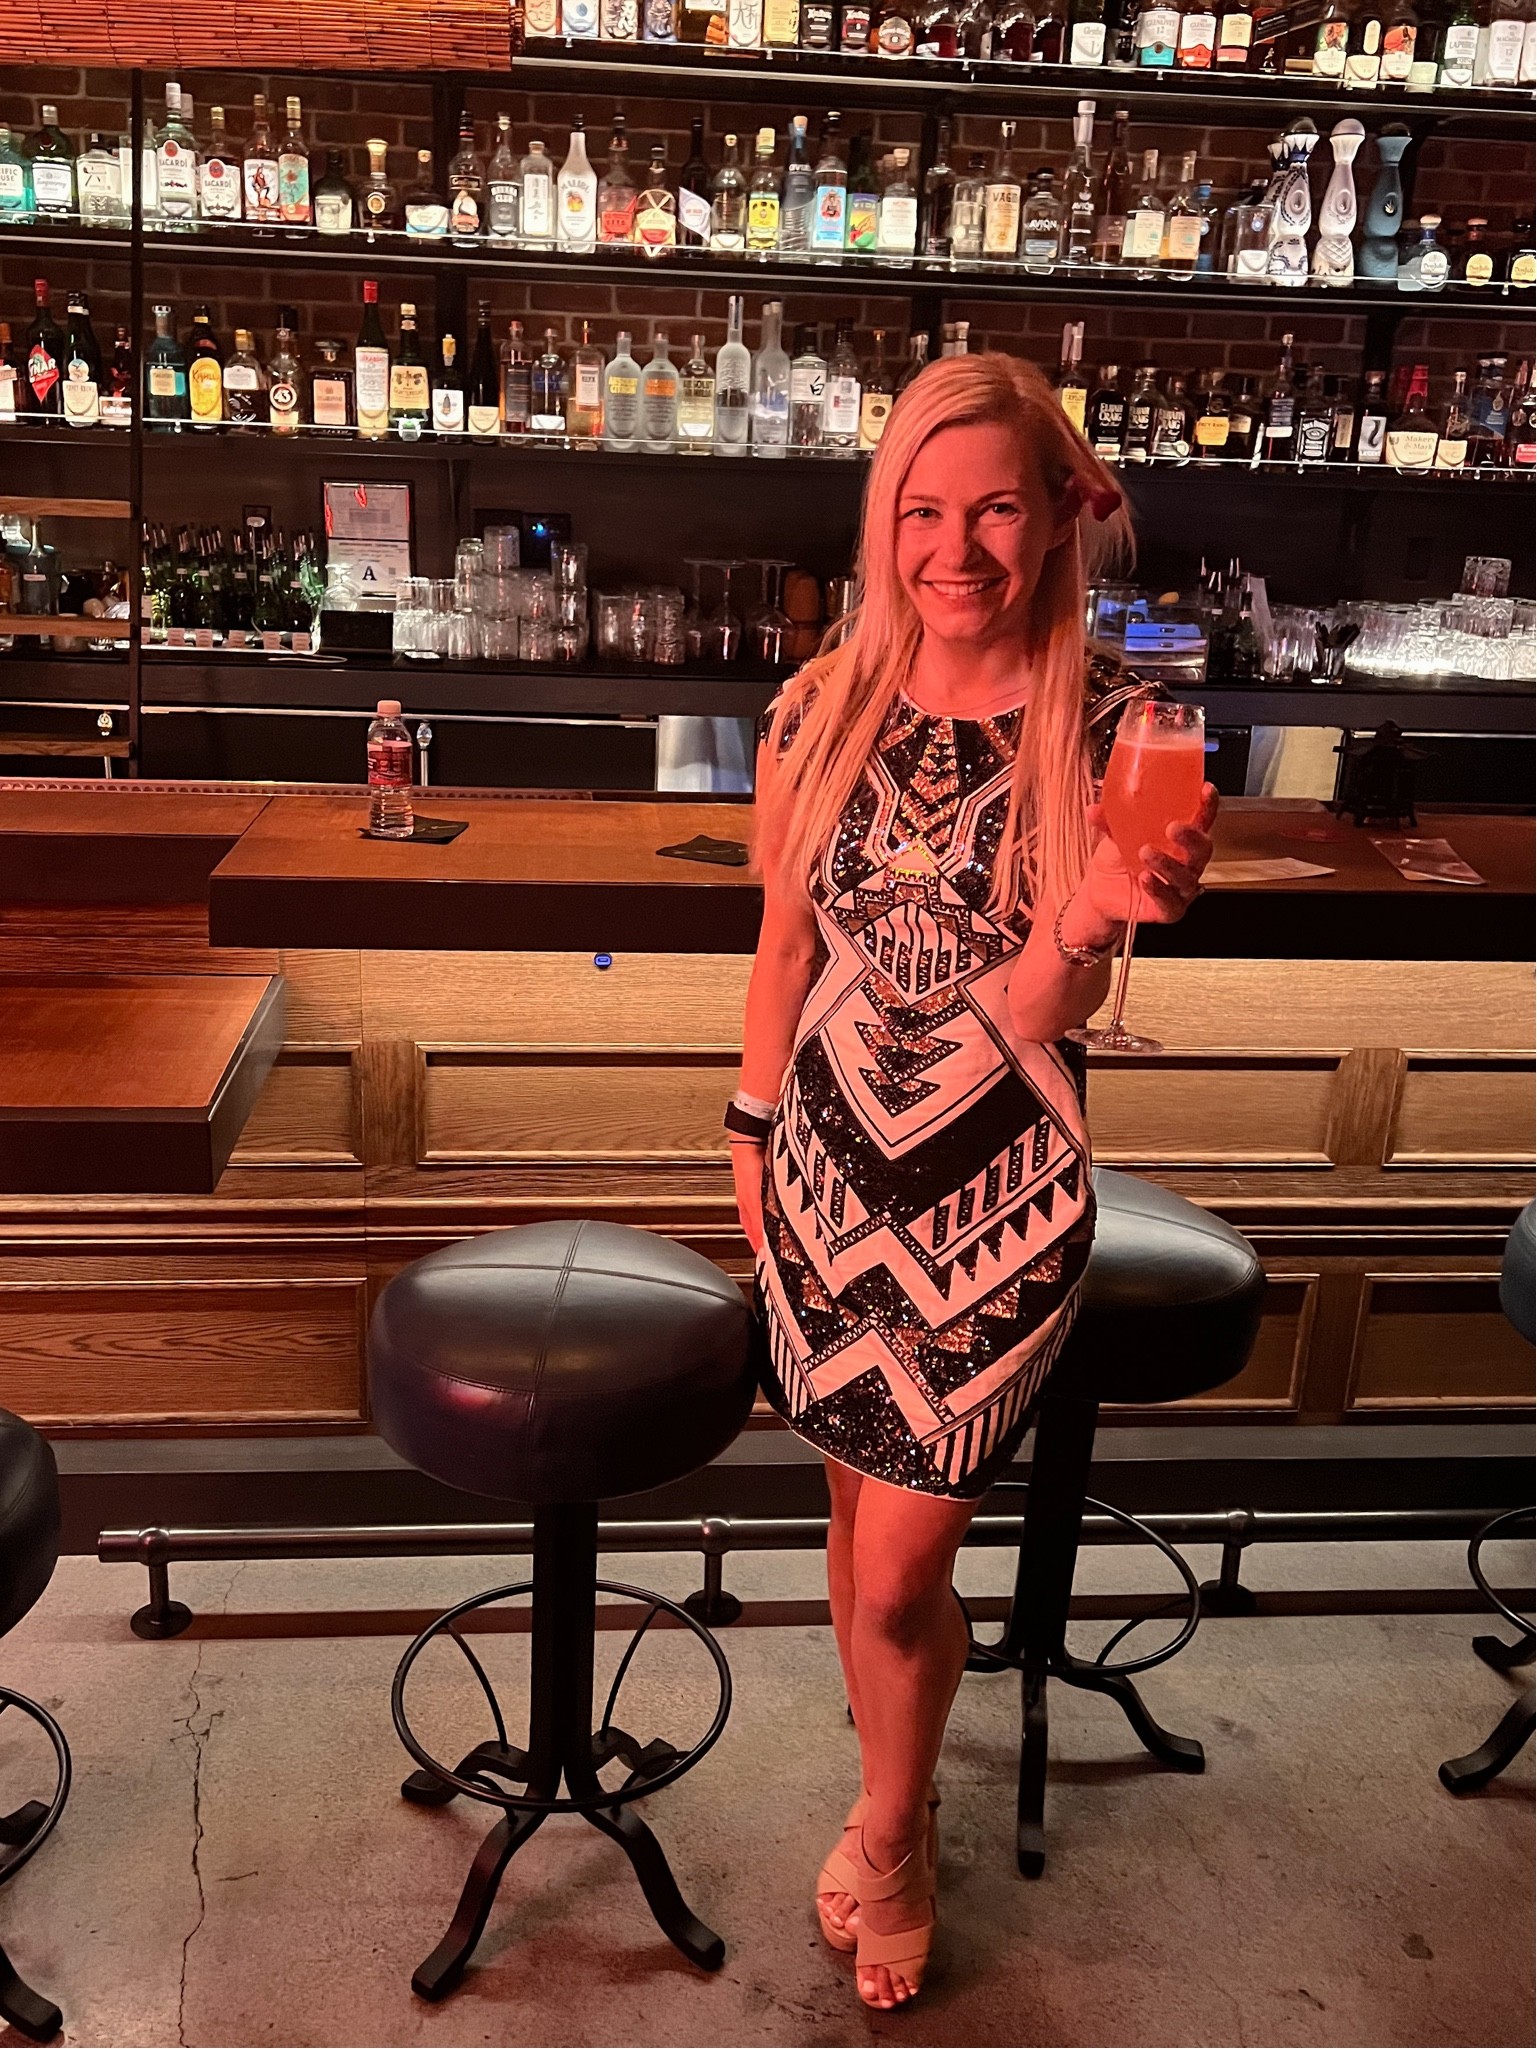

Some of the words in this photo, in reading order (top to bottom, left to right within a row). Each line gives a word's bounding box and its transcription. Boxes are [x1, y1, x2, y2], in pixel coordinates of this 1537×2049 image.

[274, 389, 291, 402] 43
[1100, 402, 1124, 413] ELIJAH
[1098, 411, 1123, 422] CRAIG
[362, 566, 377, 581] A
